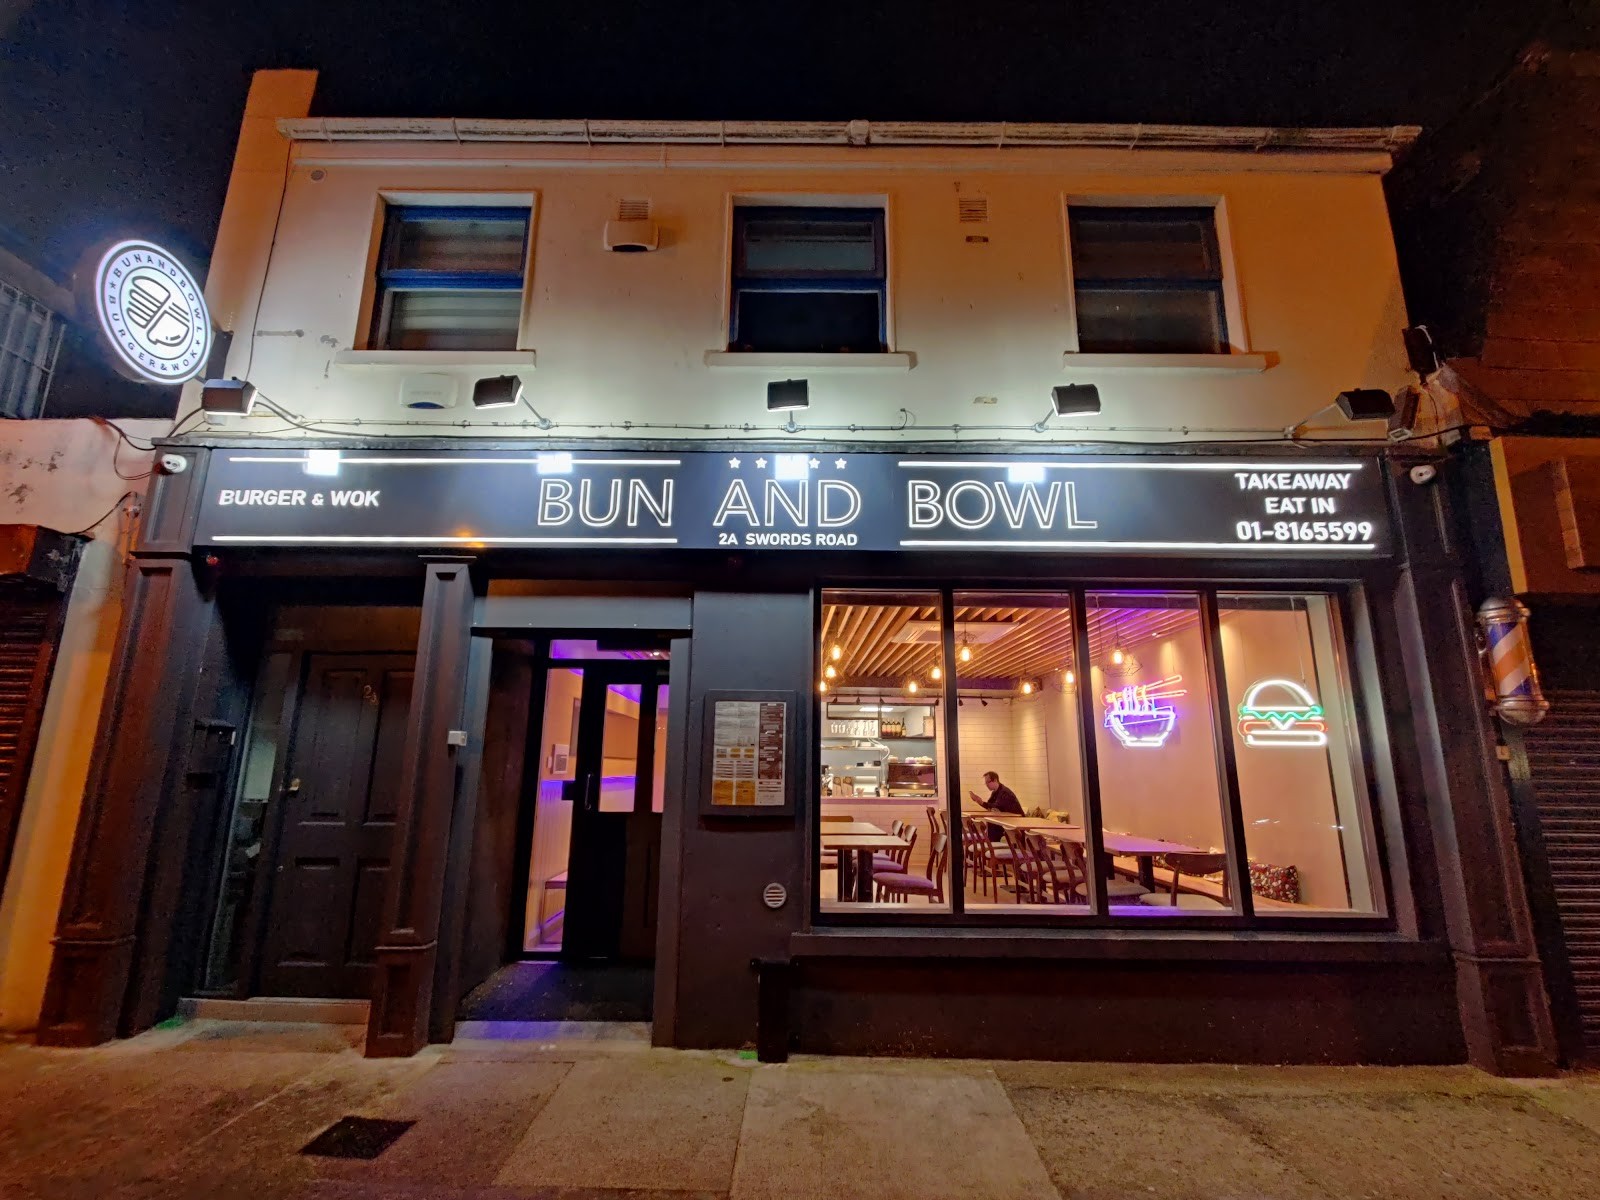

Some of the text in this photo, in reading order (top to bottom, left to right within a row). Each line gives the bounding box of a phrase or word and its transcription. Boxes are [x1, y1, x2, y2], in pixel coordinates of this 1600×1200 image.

[1234, 472, 1352, 490] TAKEAWAY
[218, 489, 381, 508] BURGER & WOK
[537, 478, 1099, 530] BUN AND BOWL
[1264, 496, 1336, 514] EAT IN
[1235, 520, 1374, 541] 01-8165599
[718, 533, 858, 547] 2A SWORDS ROAD
